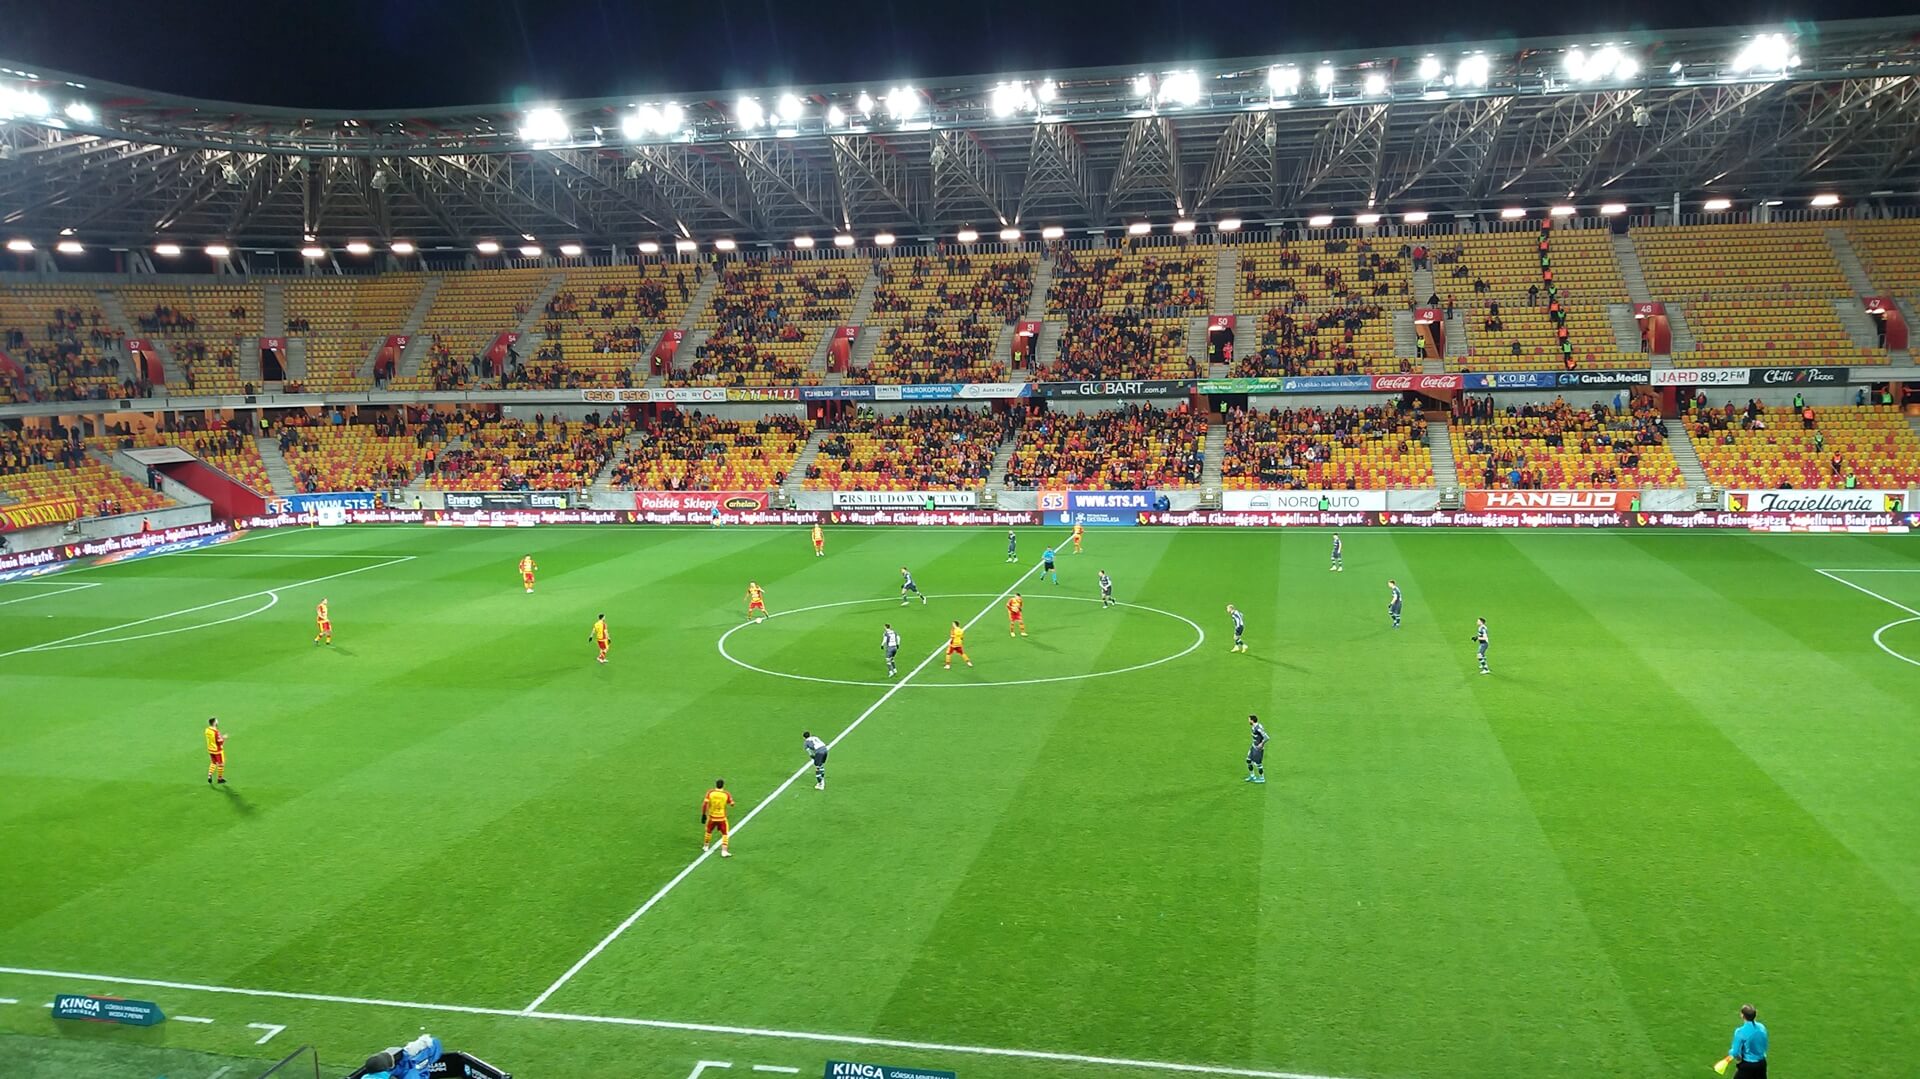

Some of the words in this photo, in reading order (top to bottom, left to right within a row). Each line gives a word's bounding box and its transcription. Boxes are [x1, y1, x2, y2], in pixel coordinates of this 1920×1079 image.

[1423, 311, 1434, 319] 49
[130, 341, 139, 349] 57
[1581, 374, 1648, 384] Grube.Media
[1659, 372, 1698, 383] JARD
[1700, 371, 1729, 382] 89,2
[1730, 371, 1745, 379] FM
[1763, 369, 1794, 383] Chilli
[1808, 369, 1834, 382] Pizza
[269, 498, 293, 514] STS
[448, 494, 482, 508] Energo
[531, 494, 561, 508] Energ
[642, 498, 679, 509] Polskie
[684, 498, 718, 510] Sklepy
[848, 495, 862, 503] RS
[1042, 494, 1064, 509] STS
[1075, 495, 1148, 507] WWW.STS.PL
[1278, 496, 1318, 507] NORD
[1487, 493, 1617, 507] HANBUD
[60, 998, 100, 1012] KINGA
[833, 1063, 884, 1079] KINGA
